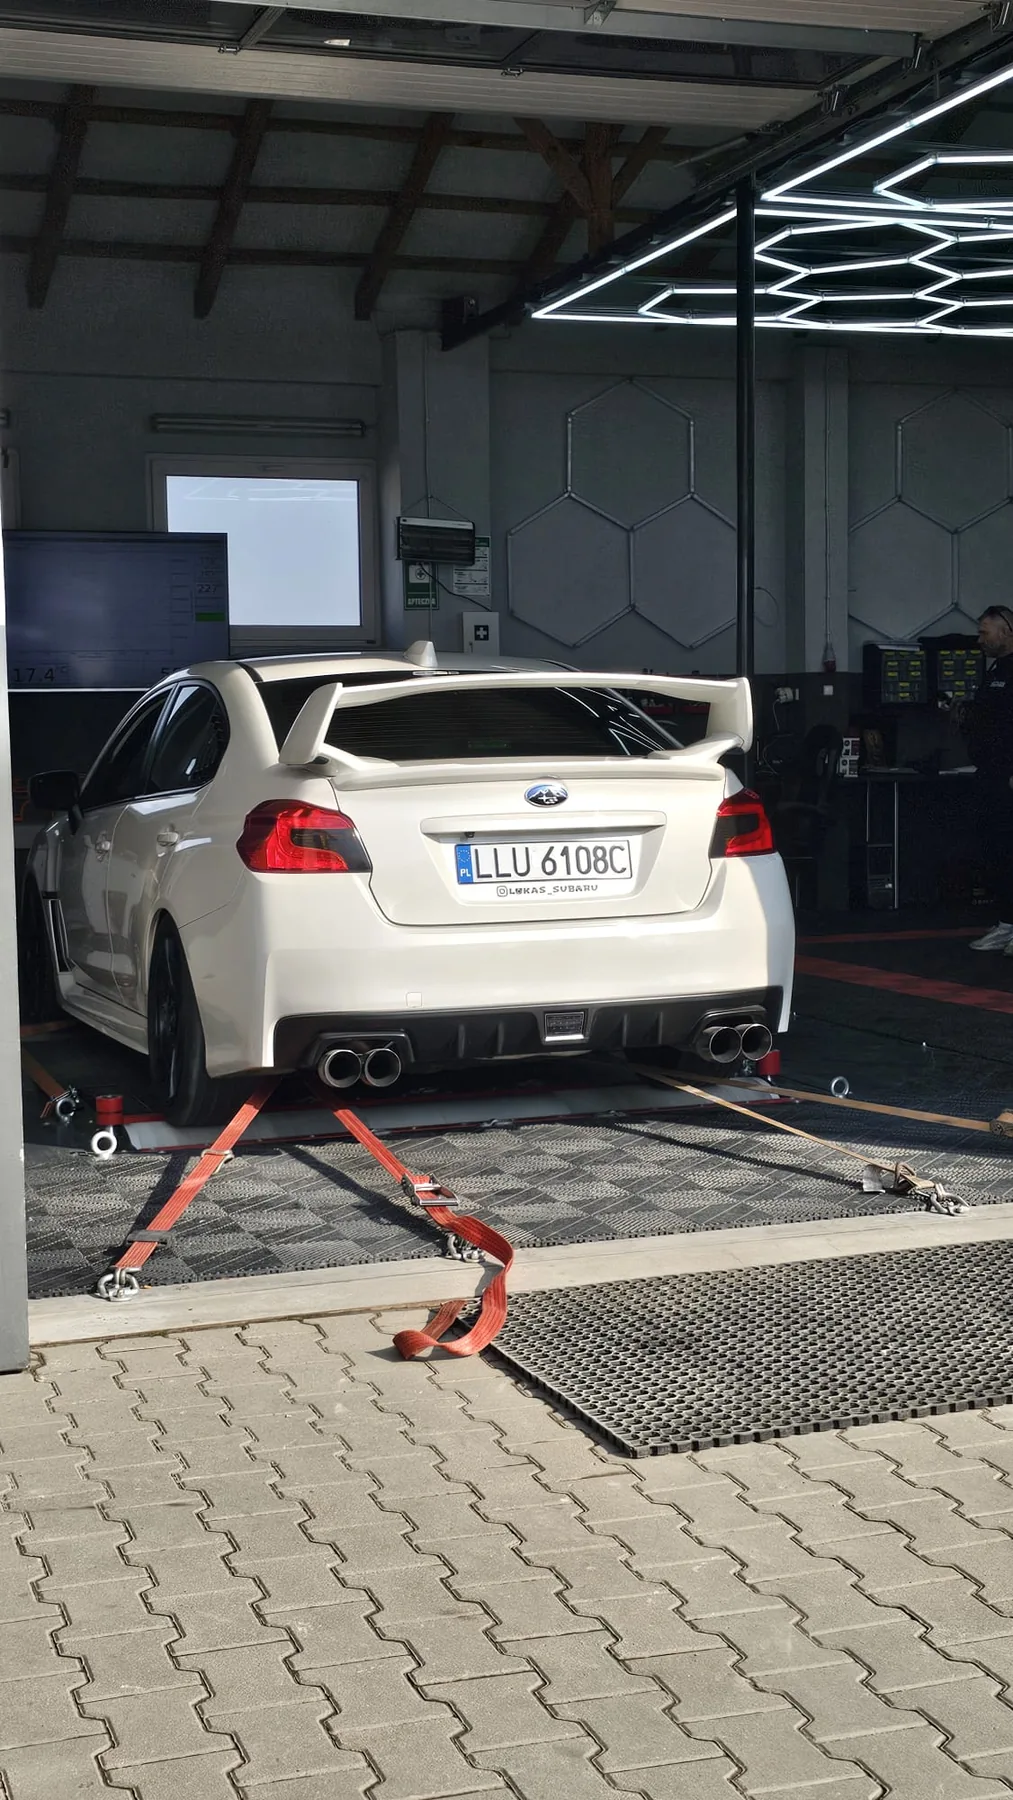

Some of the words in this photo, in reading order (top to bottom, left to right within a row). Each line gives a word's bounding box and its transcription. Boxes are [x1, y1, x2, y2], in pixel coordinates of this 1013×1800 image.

[474, 847, 531, 878] LLU
[541, 845, 627, 876] 6108C
[460, 868, 472, 877] PL
